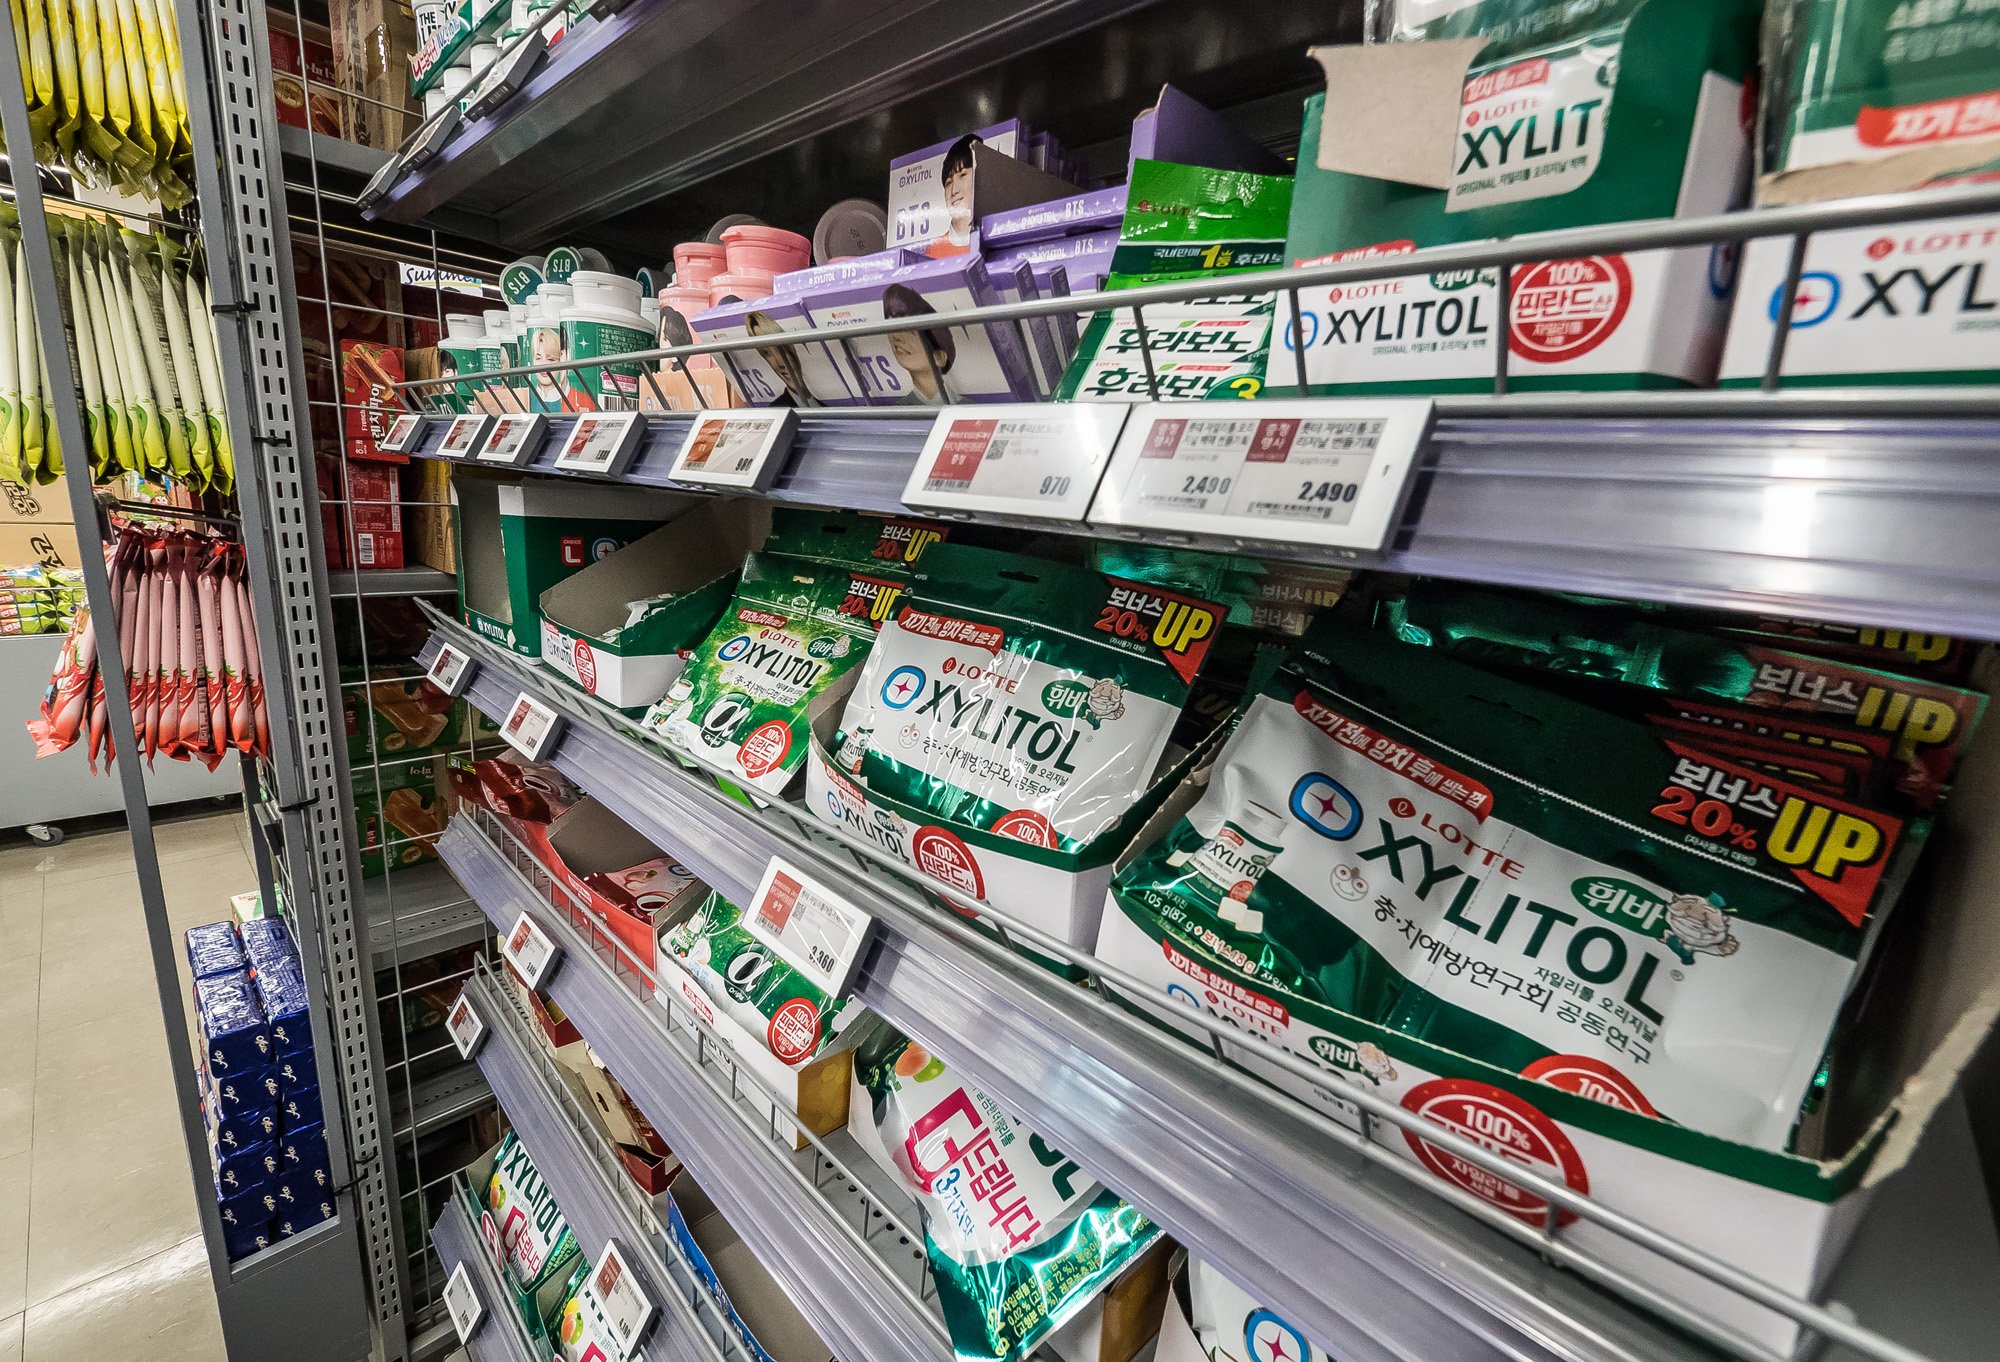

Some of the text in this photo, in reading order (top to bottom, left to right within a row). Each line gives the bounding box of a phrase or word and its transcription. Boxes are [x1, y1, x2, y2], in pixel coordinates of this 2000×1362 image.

[419, 12, 436, 26] THE
[1484, 98, 1542, 121] LOTTE
[906, 169, 932, 186] XYLITOL
[1456, 179, 1497, 196] ORIGINAL
[1065, 199, 1084, 217] BTS
[896, 201, 931, 241] BTS
[1074, 238, 1094, 254] BTS
[552, 258, 571, 273] BTS
[842, 265, 856, 279] BTS
[1548, 262, 1597, 285] 100%
[508, 270, 530, 295] BTS
[1346, 282, 1404, 301] LOTTE
[1322, 295, 1488, 347] XYLITOL
[1105, 326, 1252, 355] 후라보노
[1372, 345, 1408, 356] ORIGINAL
[1229, 377, 1261, 400] 3
[1326, 422, 1366, 436] 자일리톨
[1040, 476, 1071, 496] 970
[1182, 475, 1232, 496] 2,490
[1298, 481, 1358, 503] 2,490
[880, 525, 912, 542] 보너스
[848, 580, 878, 599] 보너스
[1107, 587, 1163, 617] 보너스
[839, 596, 870, 618] 20%
[483, 621, 507, 642] XYLITOL
[901, 612, 925, 631] 자기
[940, 619, 965, 639] 양치
[959, 624, 977, 644] 후에
[1094, 606, 1149, 642] 20%
[1153, 601, 1213, 652] UP
[768, 631, 800, 649] LOTTE
[810, 640, 833, 655] 휘바
[738, 642, 823, 690] XYLITOL
[1309, 653, 1331, 666] OPEN
[957, 663, 1019, 695] LOTTE
[1754, 663, 1859, 711] 보너스
[1047, 684, 1089, 711] 휘바
[765, 728, 781, 743] 100%
[915, 680, 1081, 774] XYLITOL
[1301, 702, 1344, 735] 자기
[1367, 739, 1415, 772] 양치
[1408, 756, 1444, 788] 후에
[1438, 778, 1470, 802] 씹는
[1465, 789, 1488, 810] 껌
[1037, 769, 1069, 786] 오리지날
[1669, 758, 1779, 819] 보너스
[1651, 786, 1757, 851] 20%
[841, 803, 910, 864] XYLITOL
[1016, 823, 1041, 845] 100%
[1767, 797, 1880, 878] UP
[932, 841, 960, 864] 100%
[1421, 812, 1525, 881] LOTTE
[1208, 843, 1266, 880] XYLITOL
[1143, 890, 1163, 908] 105
[1160, 905, 1188, 925] g(87
[1171, 894, 1189, 910] 사진
[1582, 881, 1667, 931] 휘바
[1357, 817, 1666, 1026] XYLITOL
[808, 945, 835, 974] 3,360
[1208, 972, 1235, 997] 양치
[1373, 894, 1653, 1065] 충·치예방연구회 공동연구
[1533, 965, 1660, 1043] 자일리톨 오리지날
[794, 1008, 810, 1029] 100%
[1223, 1000, 1283, 1037] LOTTE
[777, 1033, 794, 1053] 자일리톨
[1315, 1037, 1359, 1069] 휘바
[1462, 1104, 1532, 1152] 100%
[504, 1144, 562, 1247] XYLITOL
[1001, 1282, 1032, 1315] 자일리톨
[1007, 1307, 1025, 1328] 0.02
[1052, 1273, 1065, 1286] 72
